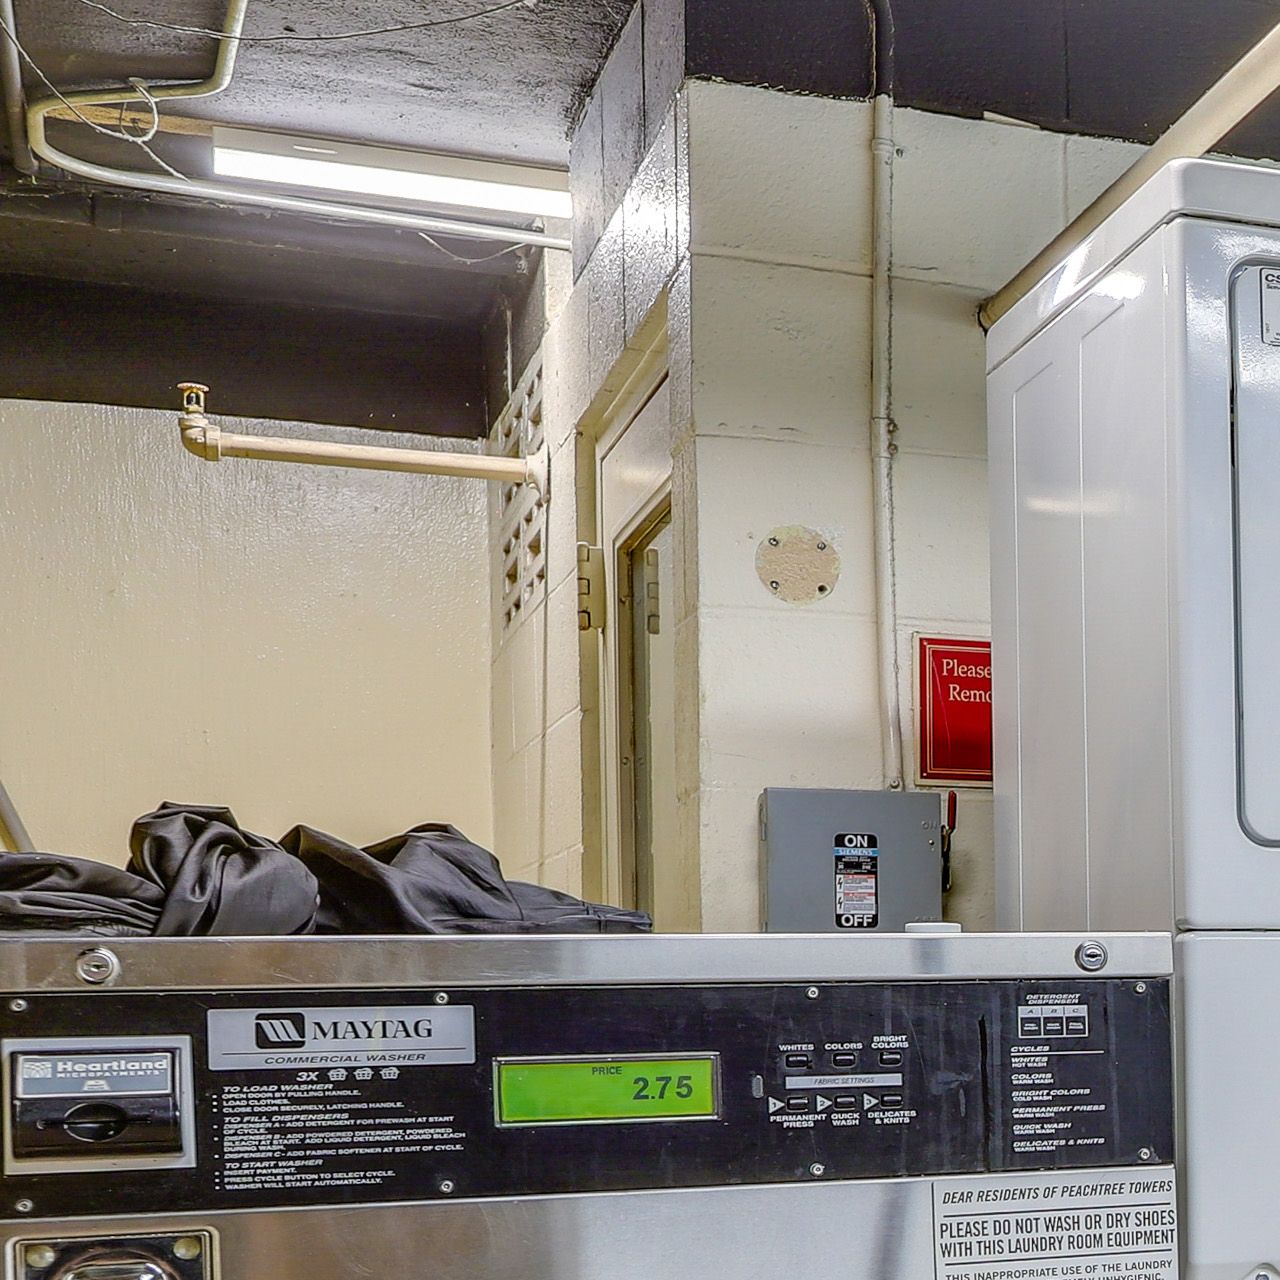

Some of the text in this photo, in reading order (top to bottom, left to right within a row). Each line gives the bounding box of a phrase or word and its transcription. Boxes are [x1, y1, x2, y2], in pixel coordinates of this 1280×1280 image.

[949, 684, 992, 703] Remo
[844, 835, 868, 847] ON
[841, 914, 873, 927] OFF
[312, 1019, 432, 1040] MAYTAG
[871, 1041, 909, 1049] COLORS
[57, 1059, 168, 1072] Heartland
[265, 1054, 426, 1065] COMMERCIAL WASHER
[296, 1072, 319, 1081] 3X
[592, 1066, 622, 1075] PRICE
[633, 1076, 692, 1100] 2.75
[272, 1113, 349, 1121] DISPENSERS
[770, 1114, 827, 1122] PERMANENT
[943, 1181, 1173, 1204] DEAR RESIDENTS OF PEACHTREE TOWERS
[940, 1210, 1174, 1239] PLEASE DO NOT WASH OR DRY SHOES
[940, 1229, 1175, 1258] WITH THIS LAUNDRY ROOM EQUIPMENT
[1061, 1266, 1081, 1275] USE
[1085, 1265, 1099, 1273] OF
[1102, 1263, 1121, 1272] THE
[1125, 1260, 1173, 1271] LAUNDRY
